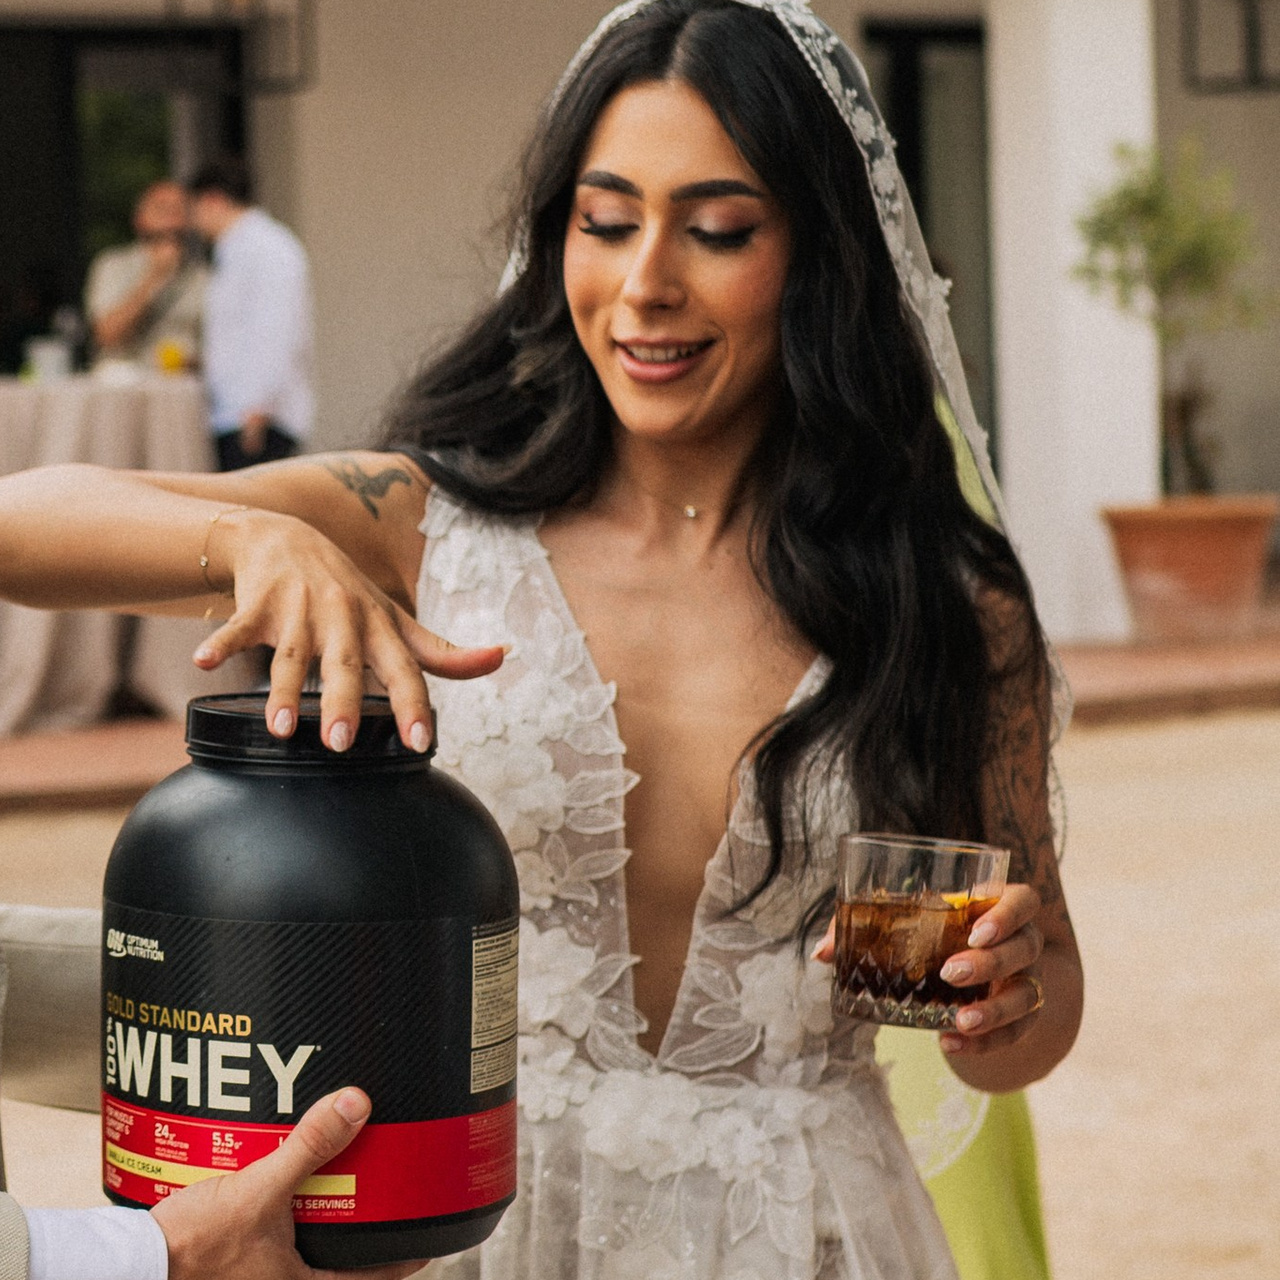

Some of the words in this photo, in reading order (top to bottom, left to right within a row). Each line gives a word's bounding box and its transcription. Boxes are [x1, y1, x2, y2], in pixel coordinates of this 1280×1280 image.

[127, 934, 159, 950] OPTIMUM
[127, 945, 165, 962] NUTRITION
[139, 1002, 252, 1037] STANDARD
[115, 1021, 316, 1115] WHEY
[127, 1157, 136, 1169] ICE
[137, 1161, 162, 1175] CREAM
[154, 1183, 169, 1195] NET
[304, 1199, 356, 1210] SERVINGS
